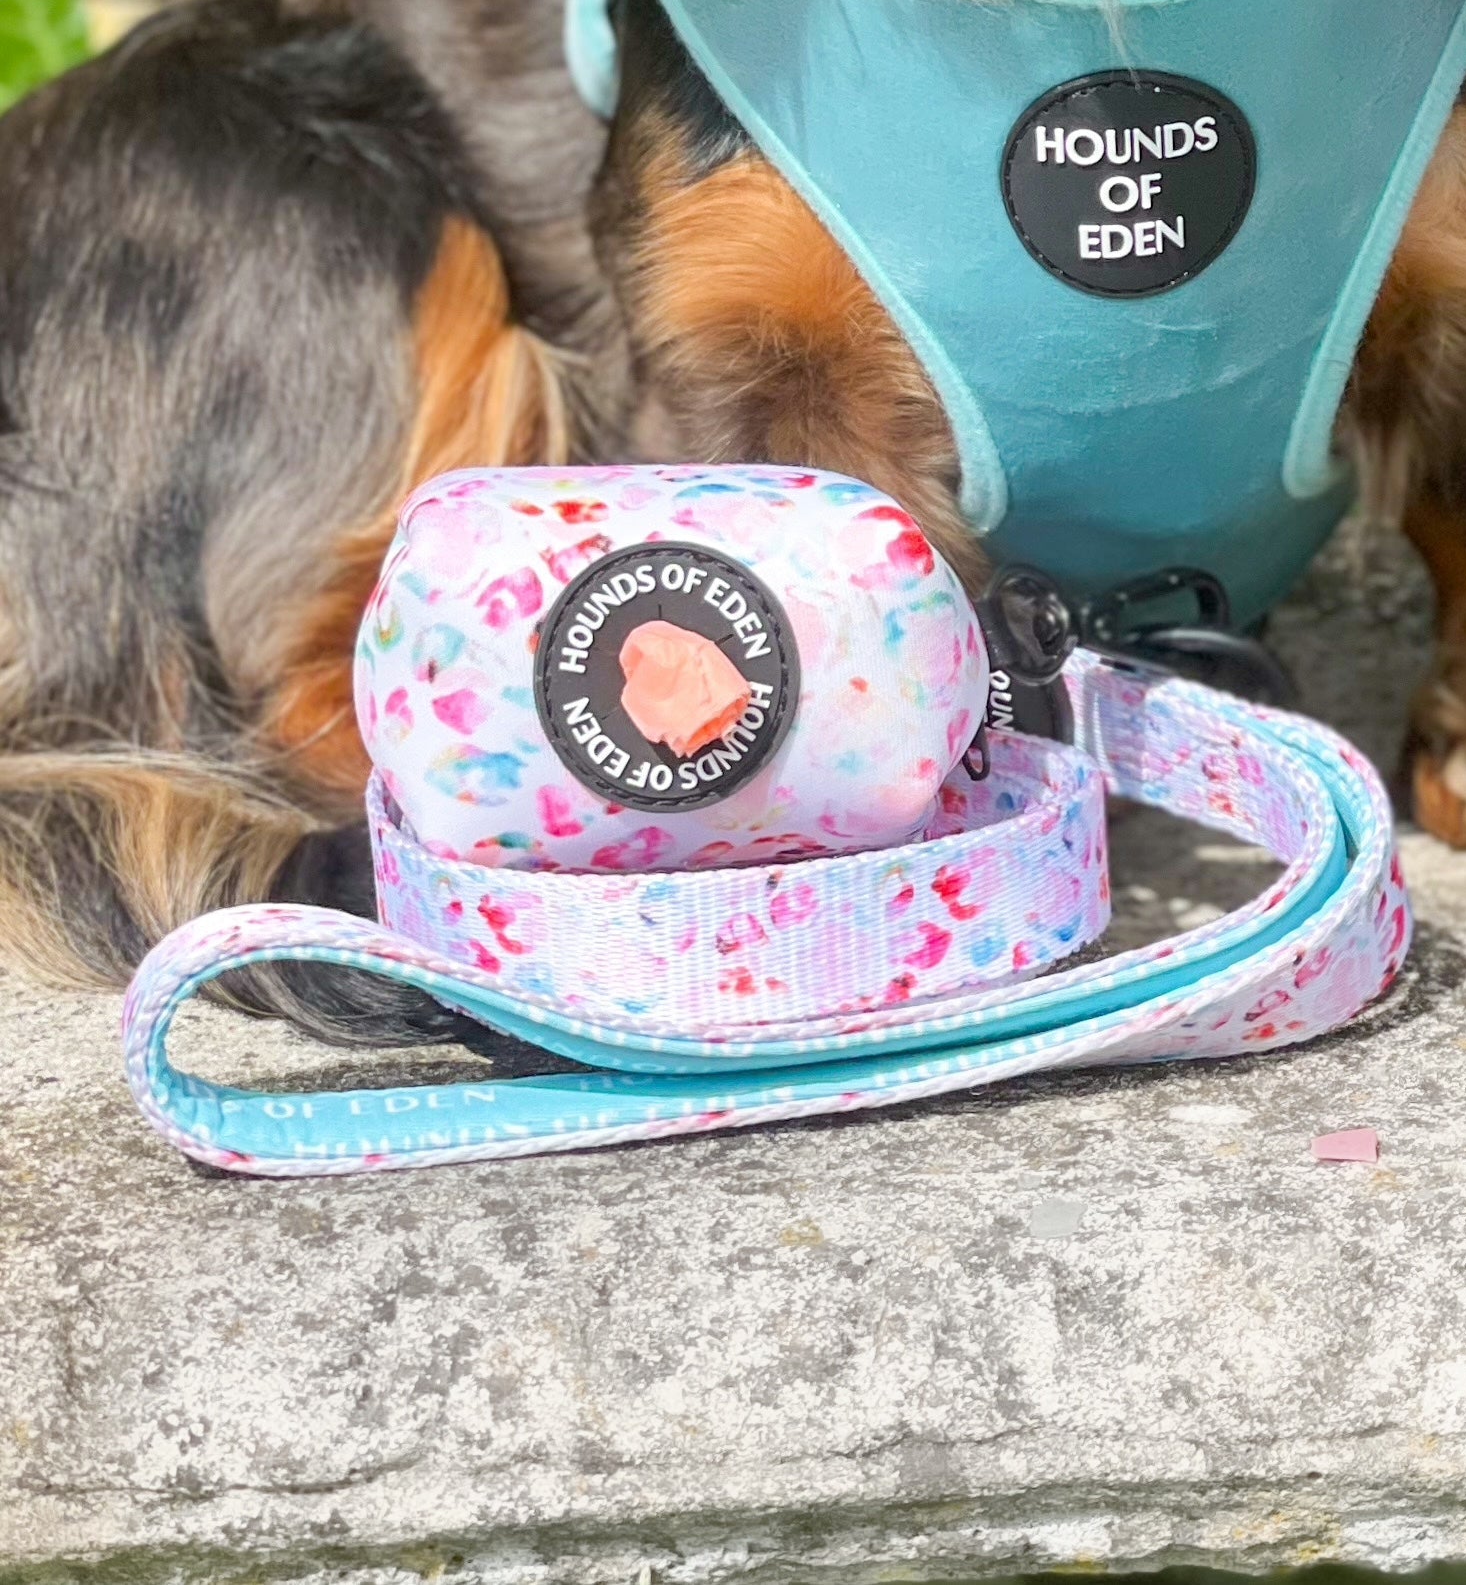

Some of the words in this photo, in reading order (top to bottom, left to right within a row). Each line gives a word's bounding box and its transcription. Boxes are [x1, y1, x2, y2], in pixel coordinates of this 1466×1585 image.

[1035, 116, 1218, 166] HOUNDS
[1099, 172, 1162, 213] OF
[1078, 215, 1185, 260] EDEN
[558, 565, 656, 674] HOUNDS
[661, 563, 708, 594] OF
[704, 577, 772, 660] EDEN
[563, 696, 631, 779] EDEN
[677, 680, 774, 790] HOUNDS
[626, 761, 674, 792] OF
[350, 1088, 496, 1116] EDEN
